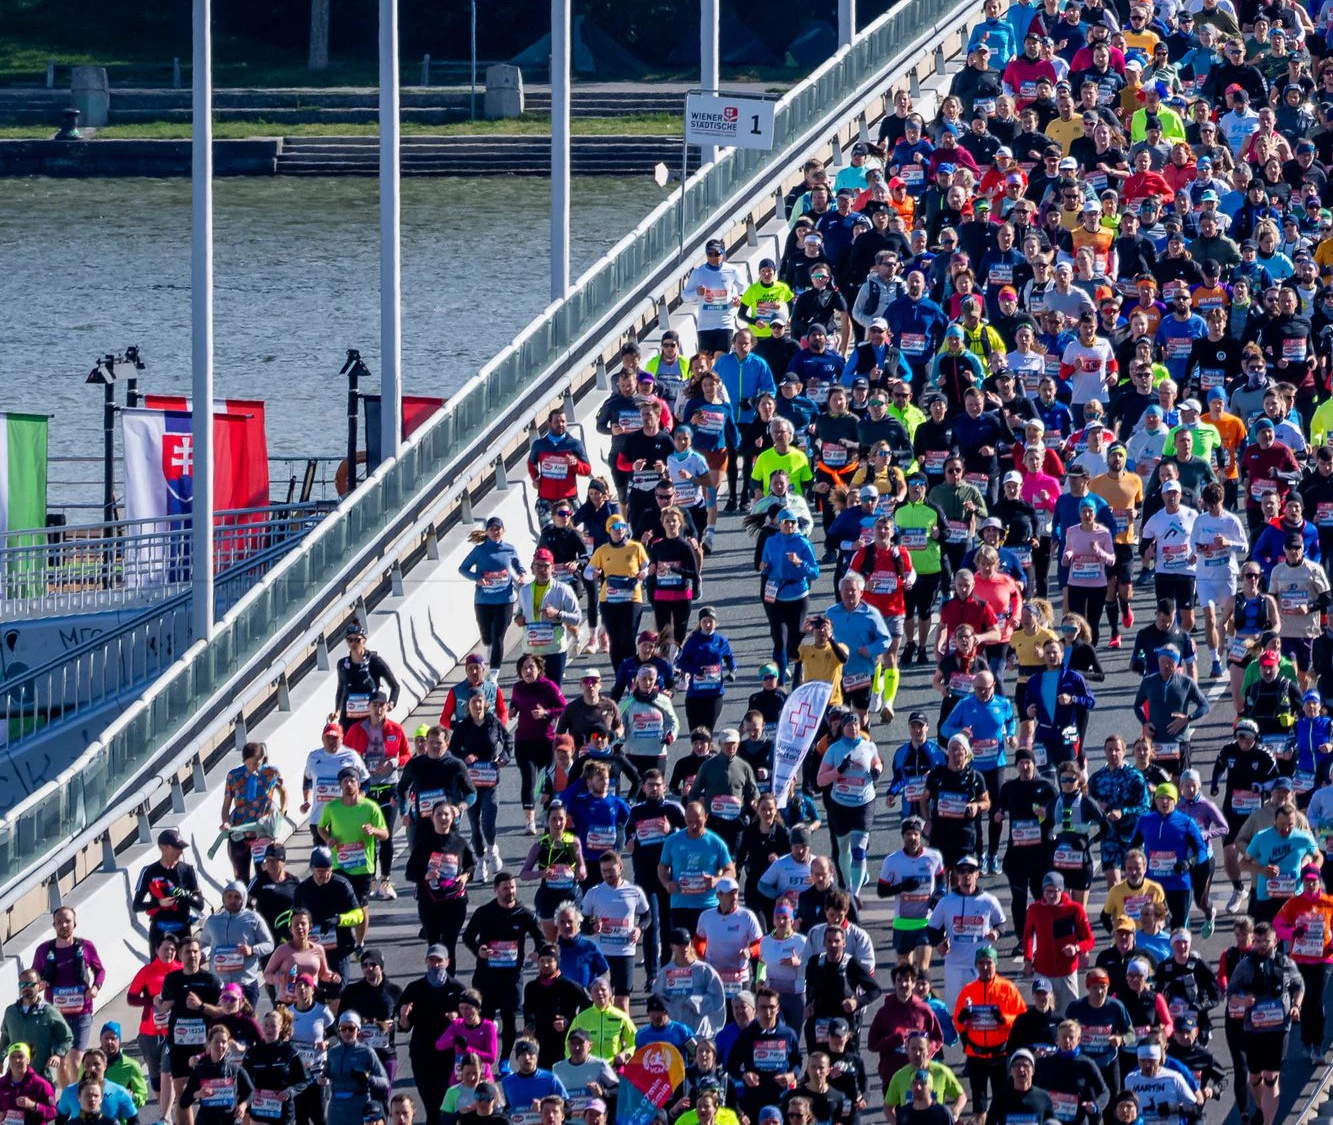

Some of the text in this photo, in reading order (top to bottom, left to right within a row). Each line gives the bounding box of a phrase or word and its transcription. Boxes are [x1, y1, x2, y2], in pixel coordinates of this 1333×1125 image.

[691, 112, 723, 122] WIENER
[750, 114, 762, 135] 1
[1132, 1083, 1166, 1094] MARTIN
